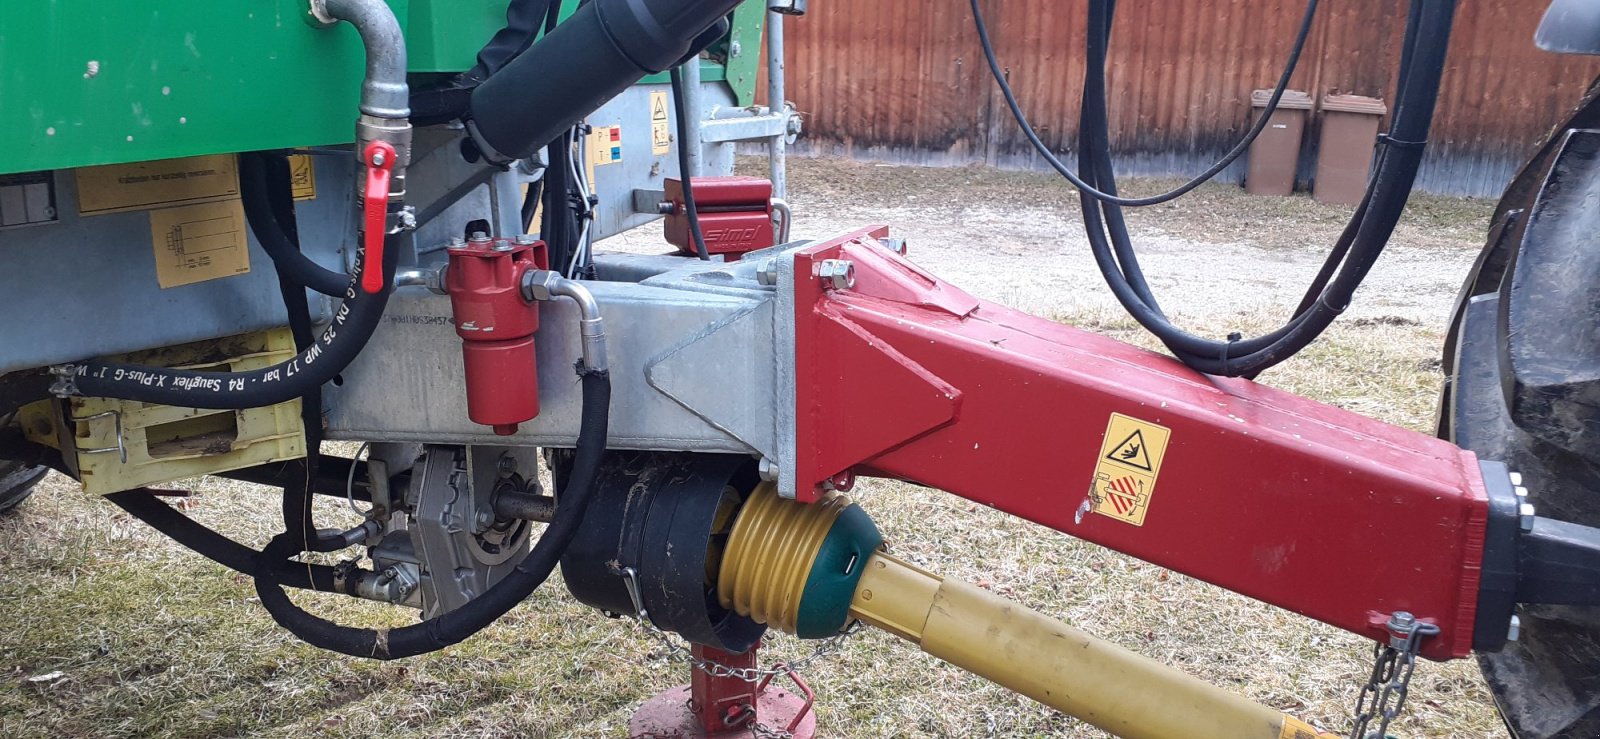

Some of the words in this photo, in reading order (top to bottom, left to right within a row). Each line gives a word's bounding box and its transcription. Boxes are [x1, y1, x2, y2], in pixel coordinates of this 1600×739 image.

[336, 303, 350, 325] DN
[323, 325, 337, 345] 25
[304, 344, 323, 364] WP
[77, 365, 88, 377] W
[262, 370, 281, 383] bar
[286, 359, 300, 377] 17
[114, 368, 168, 387] X-Plus-G
[172, 376, 222, 392] Saugflex
[228, 378, 245, 391] R4
